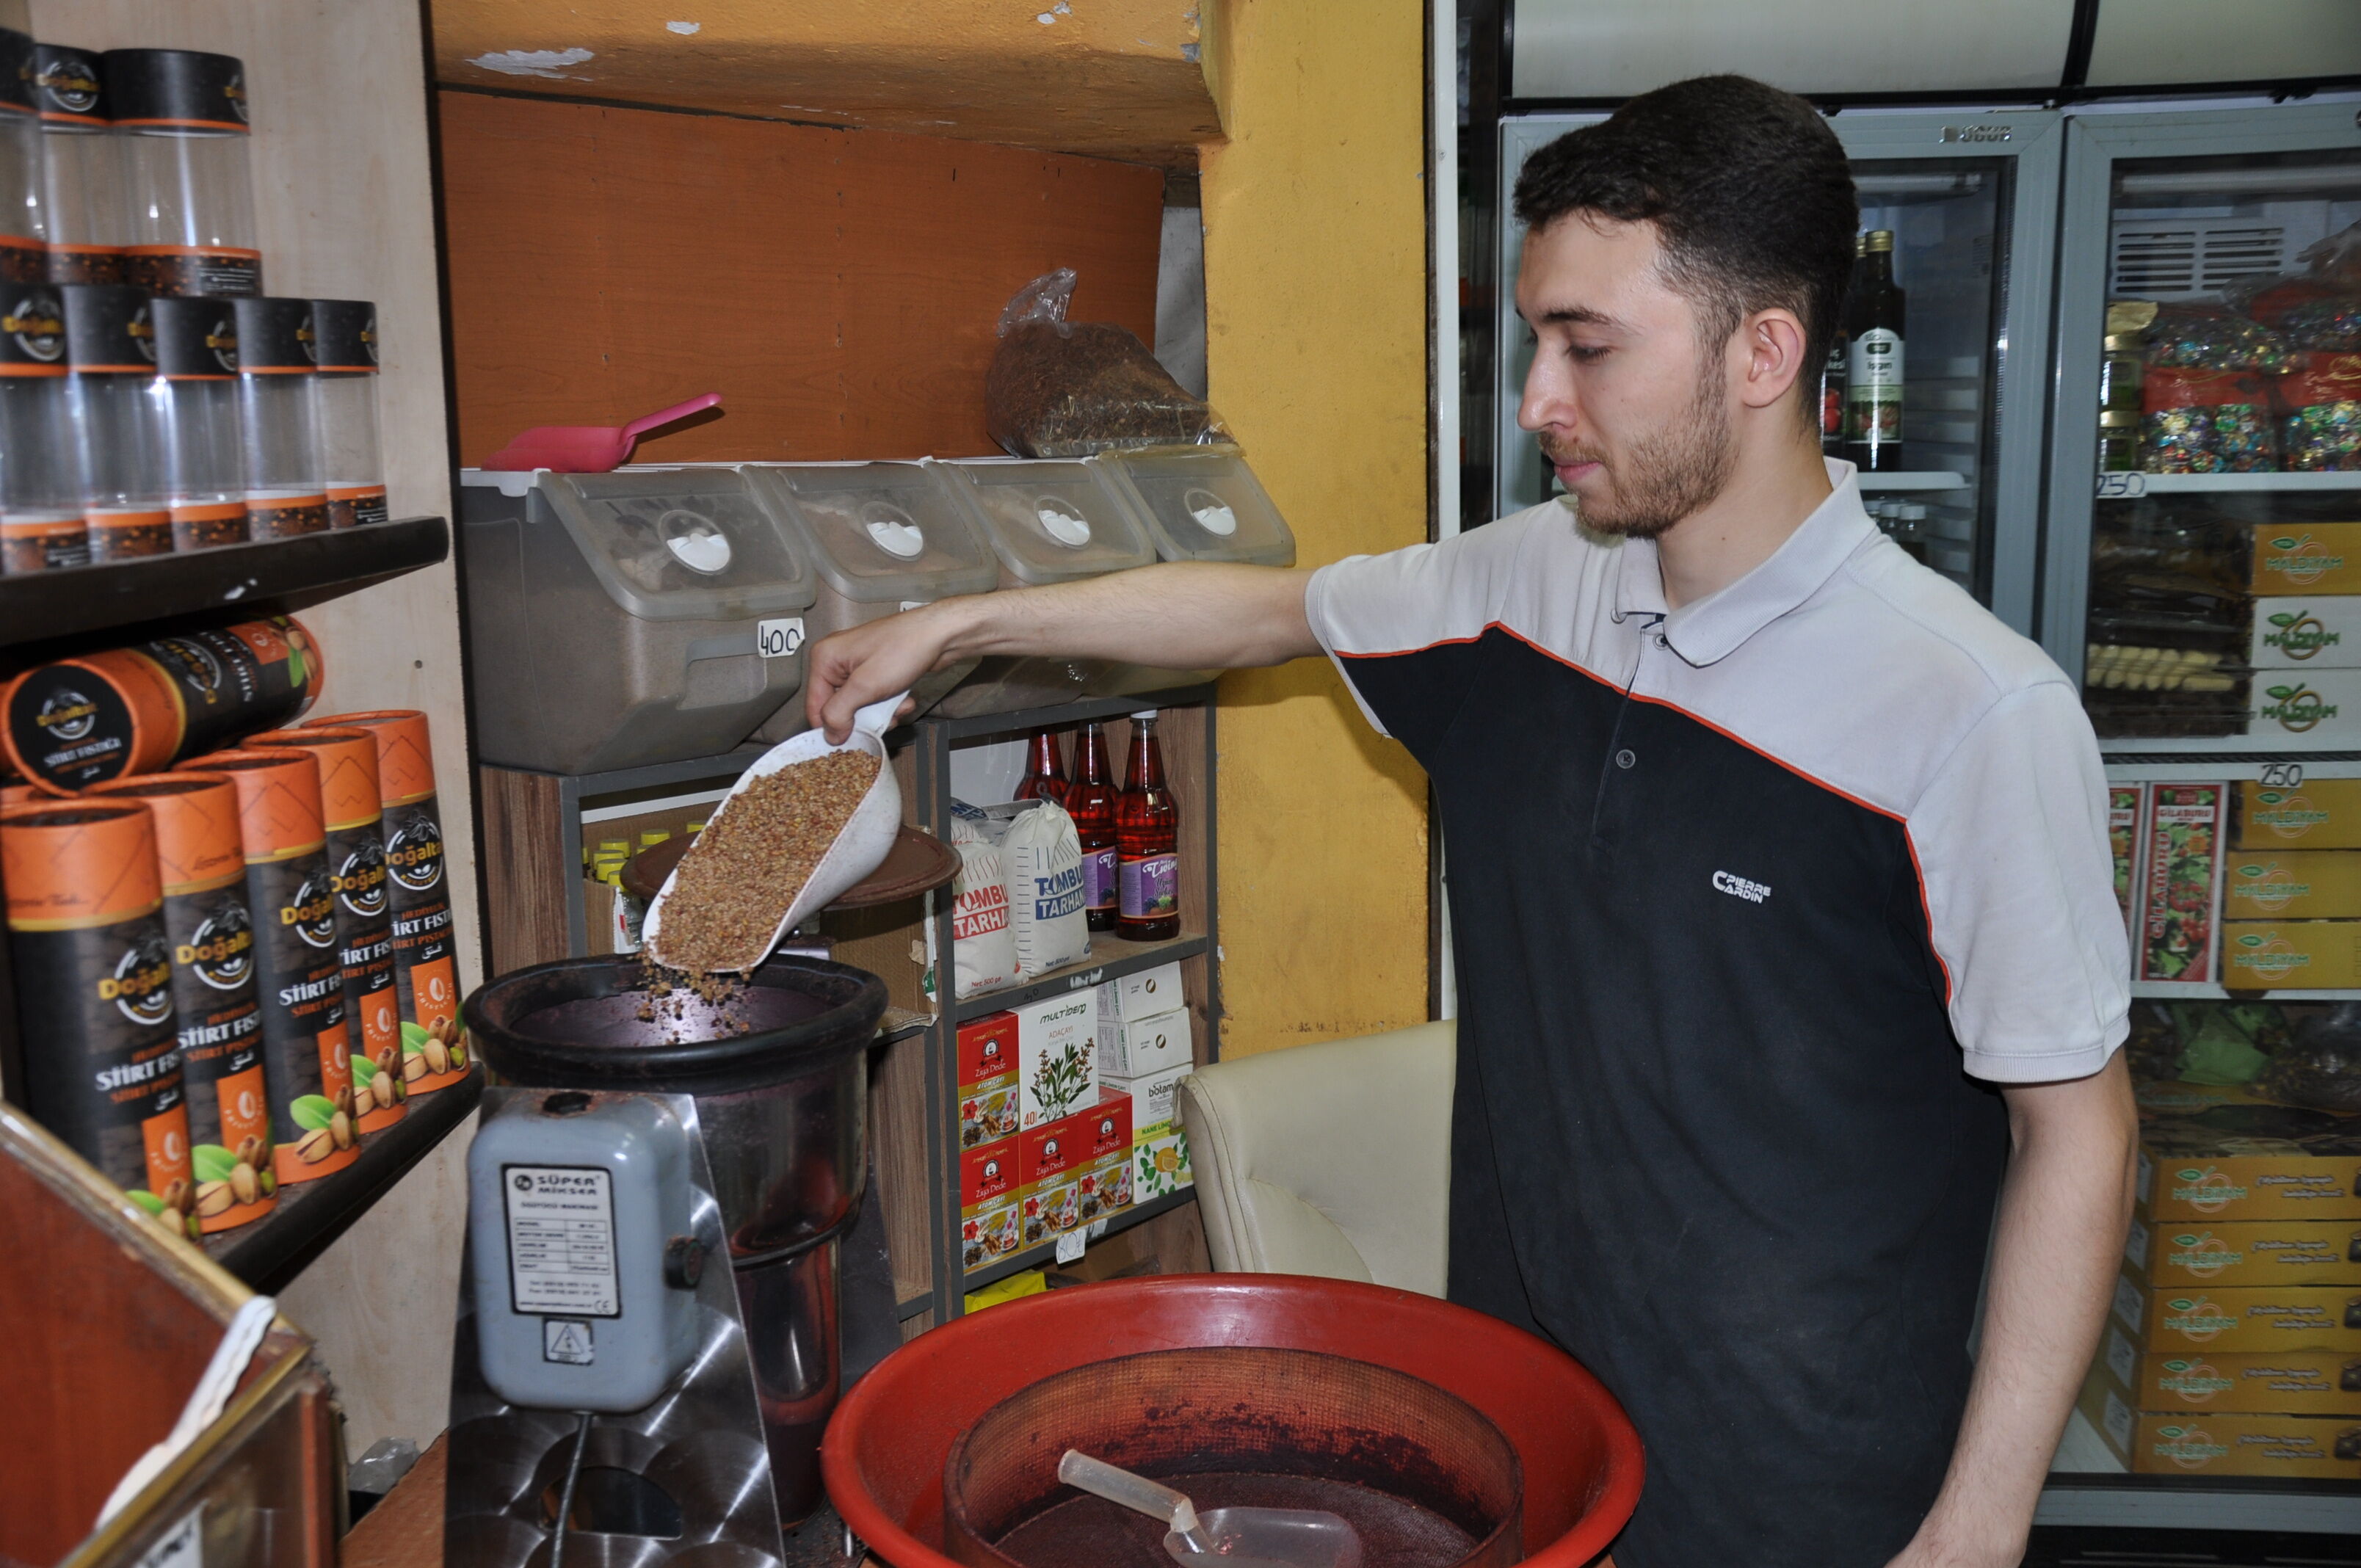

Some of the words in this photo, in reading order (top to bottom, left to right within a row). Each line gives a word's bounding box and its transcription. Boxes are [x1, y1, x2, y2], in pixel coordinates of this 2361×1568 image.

[2260, 763, 2303, 788] 250
[1712, 870, 1763, 904] CARDIN
[1726, 874, 1771, 897] PIERRE
